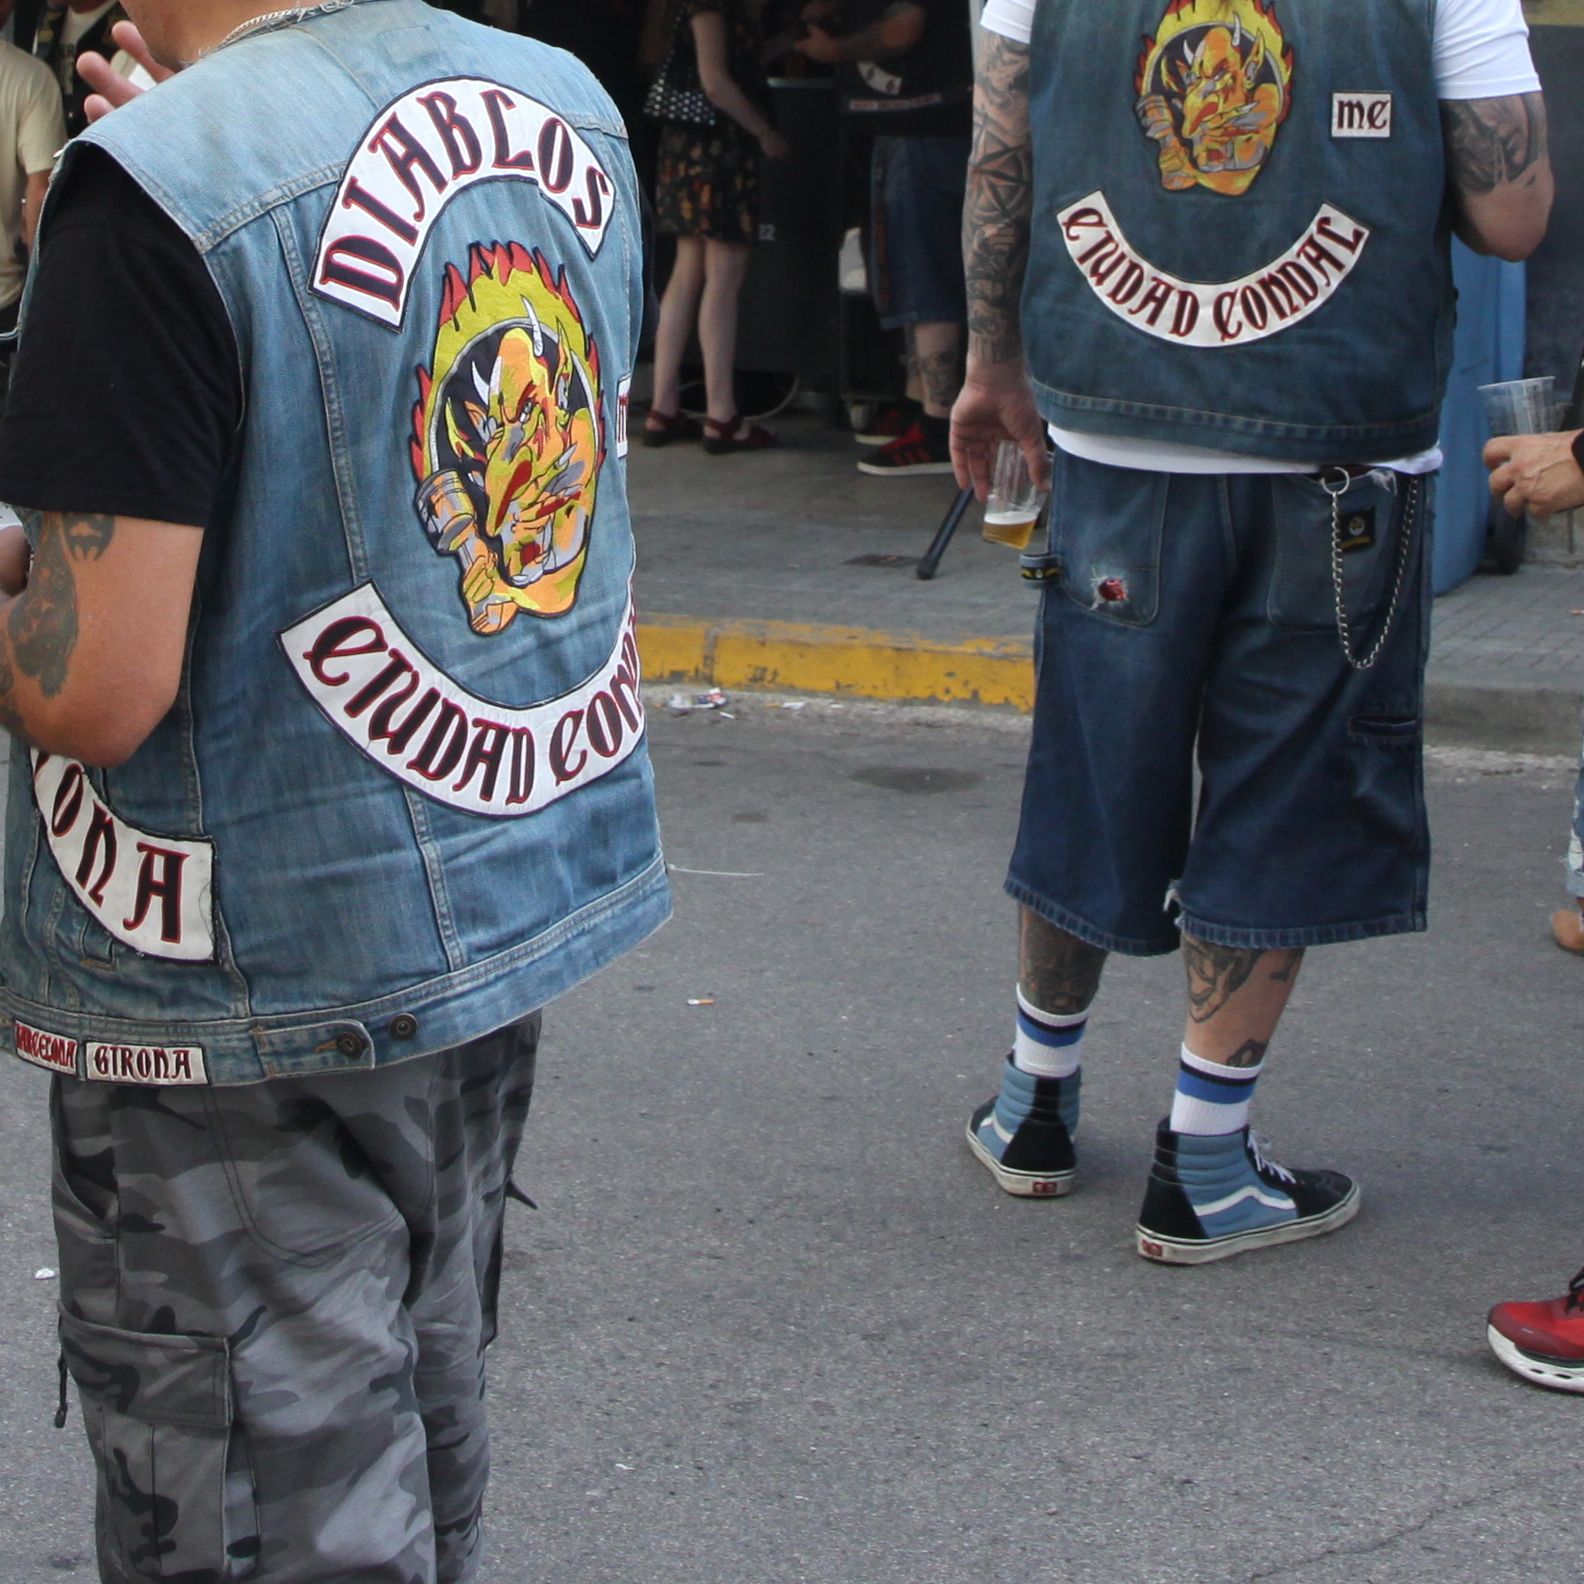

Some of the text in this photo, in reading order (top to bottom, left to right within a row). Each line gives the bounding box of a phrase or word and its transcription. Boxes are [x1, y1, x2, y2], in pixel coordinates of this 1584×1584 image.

[319, 87, 612, 313] DIABLOS
[1062, 206, 1368, 343] CIUDAD CONDAL
[302, 614, 536, 806] CIUDAD
[93, 1045, 194, 1081] GIRONA
